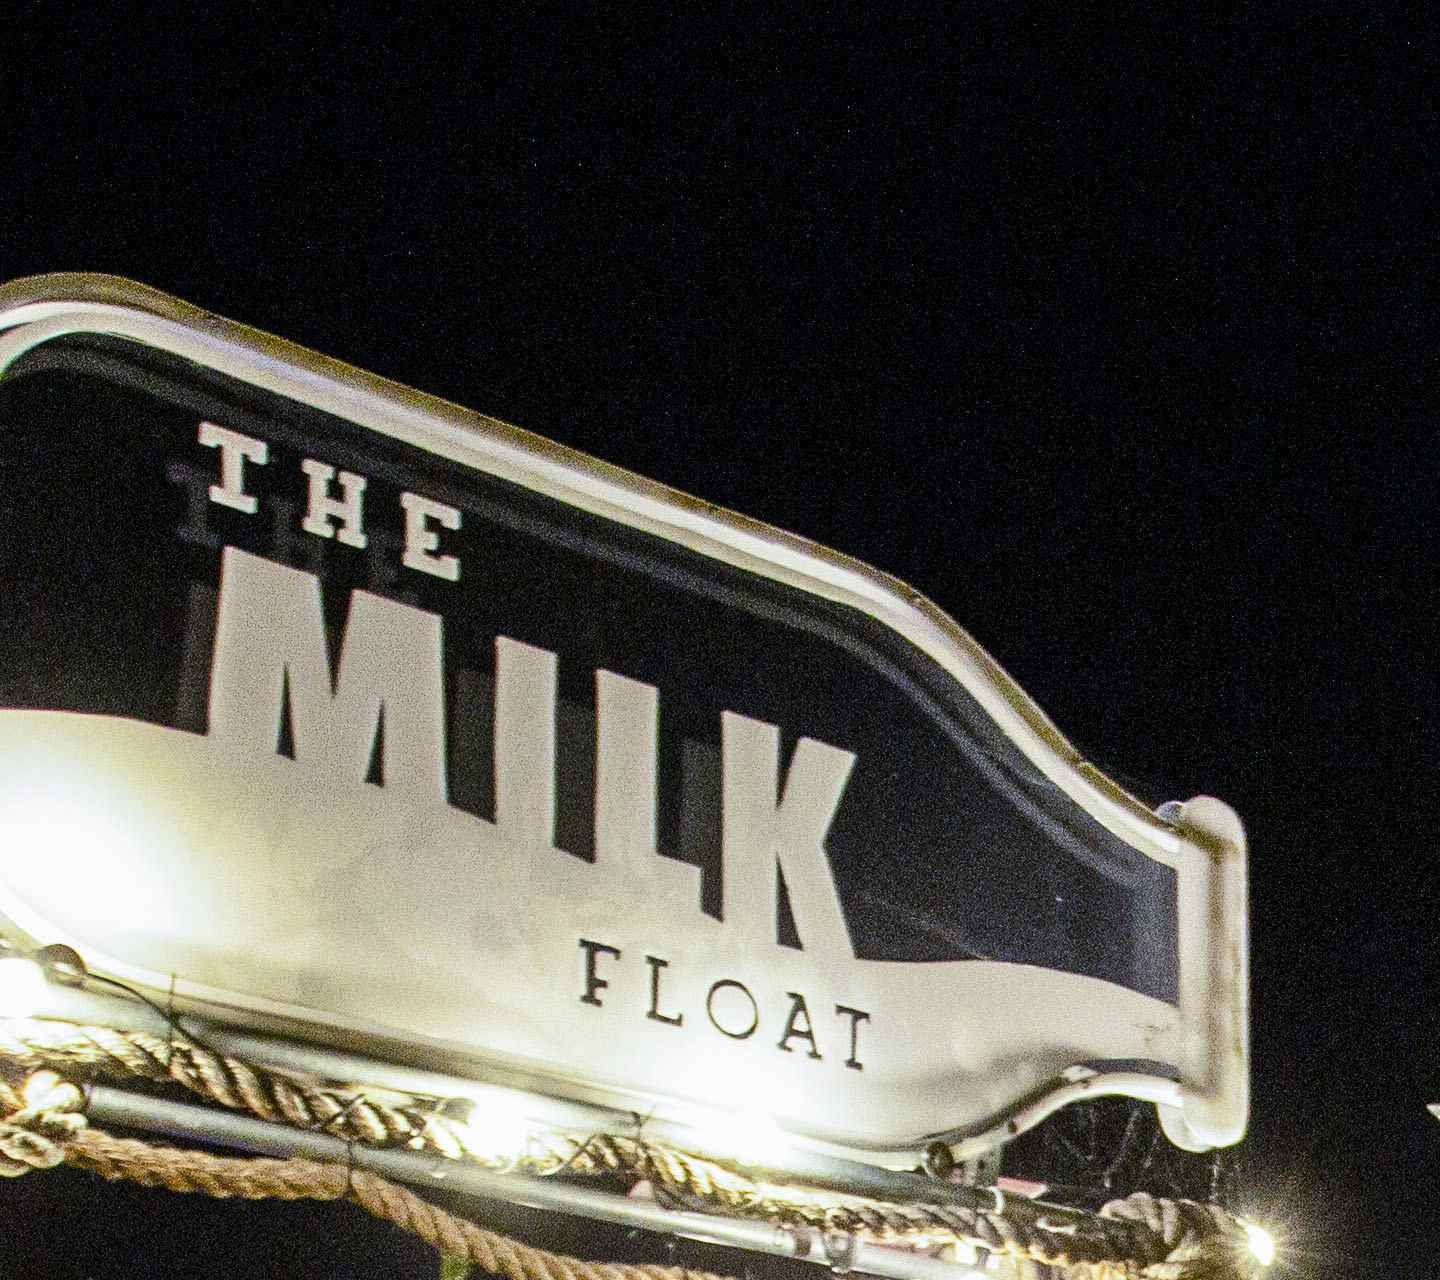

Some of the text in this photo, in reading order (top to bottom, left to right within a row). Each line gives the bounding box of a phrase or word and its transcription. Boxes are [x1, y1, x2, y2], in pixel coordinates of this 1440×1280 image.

[196, 420, 464, 584] THE
[206, 546, 859, 962] MILK
[577, 938, 873, 1075] FLOAT
